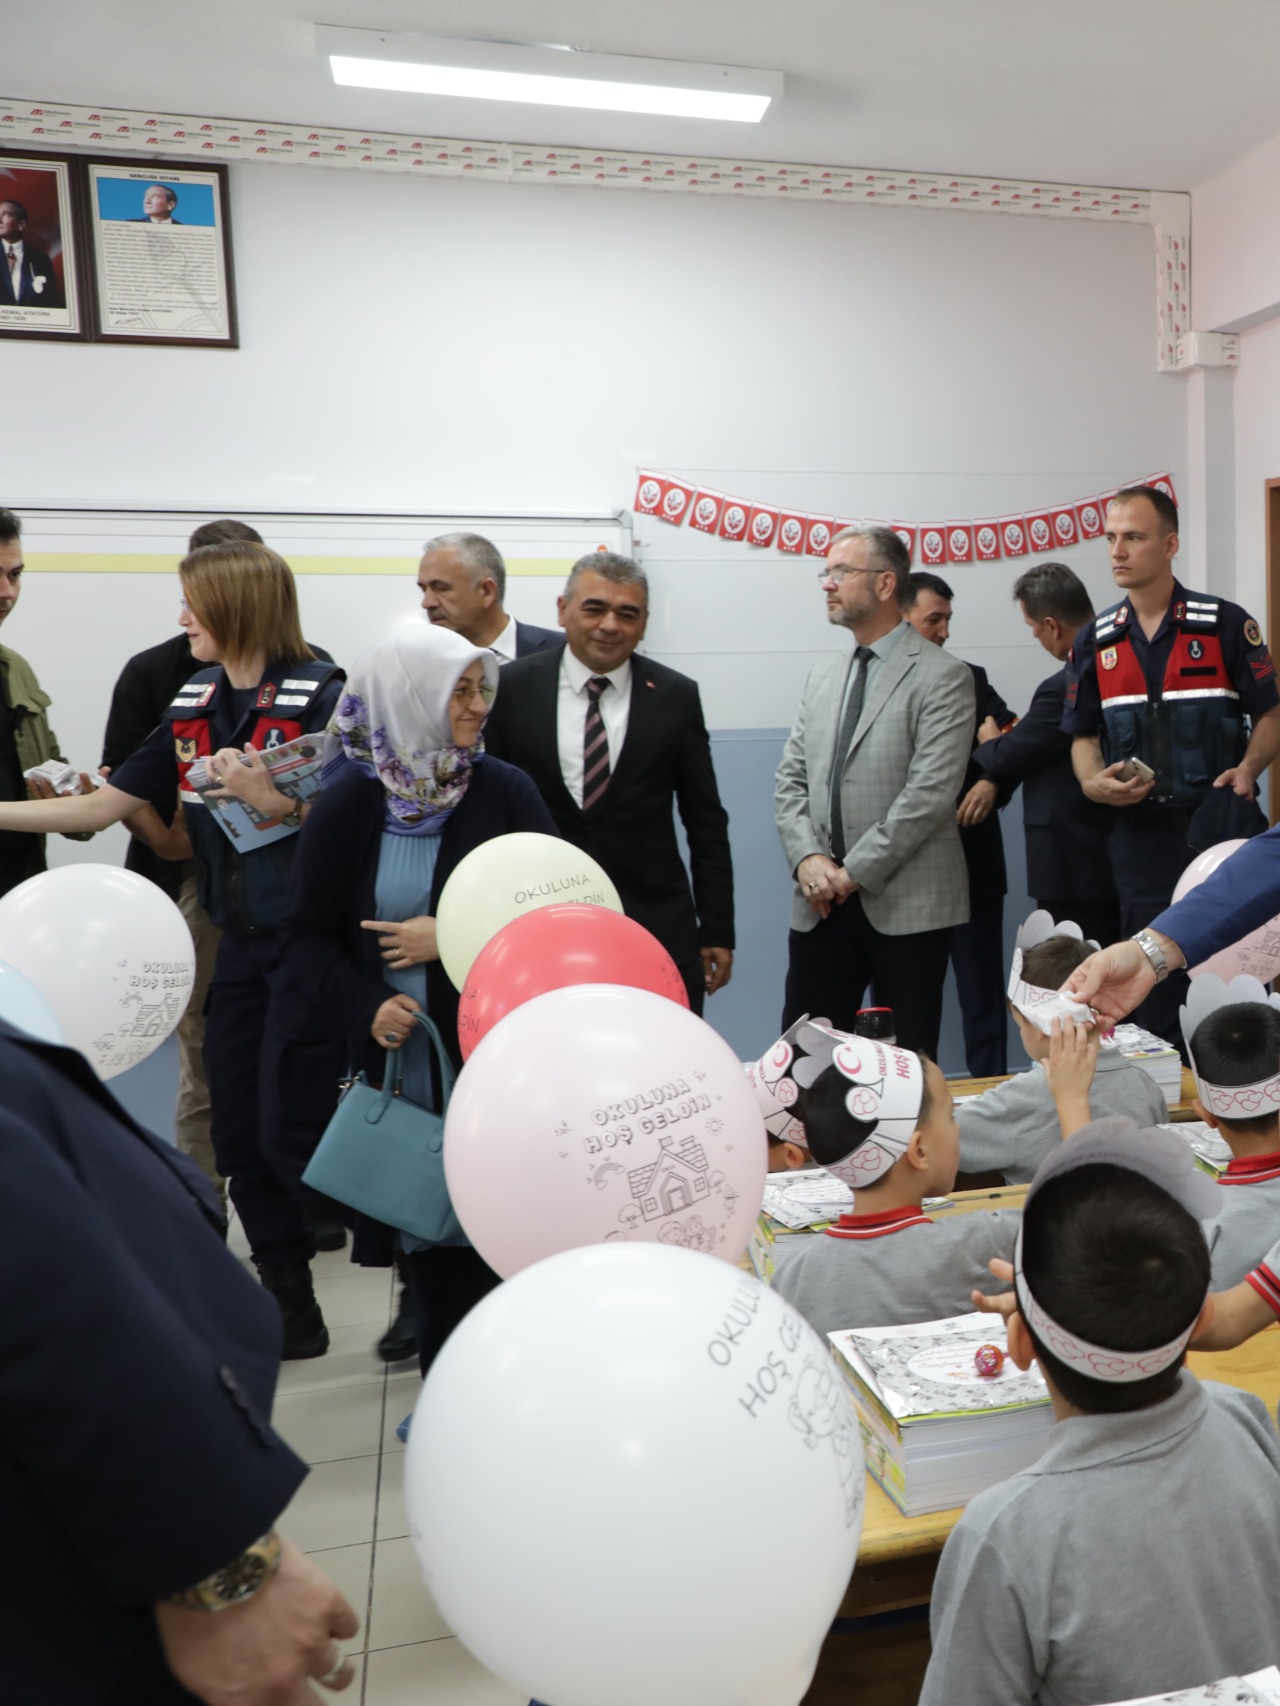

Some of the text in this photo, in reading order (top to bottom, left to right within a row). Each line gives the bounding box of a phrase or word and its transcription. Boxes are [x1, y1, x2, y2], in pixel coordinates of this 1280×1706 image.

[514, 873, 592, 905] OKULUNA
[583, 1093, 713, 1155] HOŞ GELDİN
[591, 1077, 692, 1127] OKULUNA
[738, 1349, 793, 1419] HOŞ
